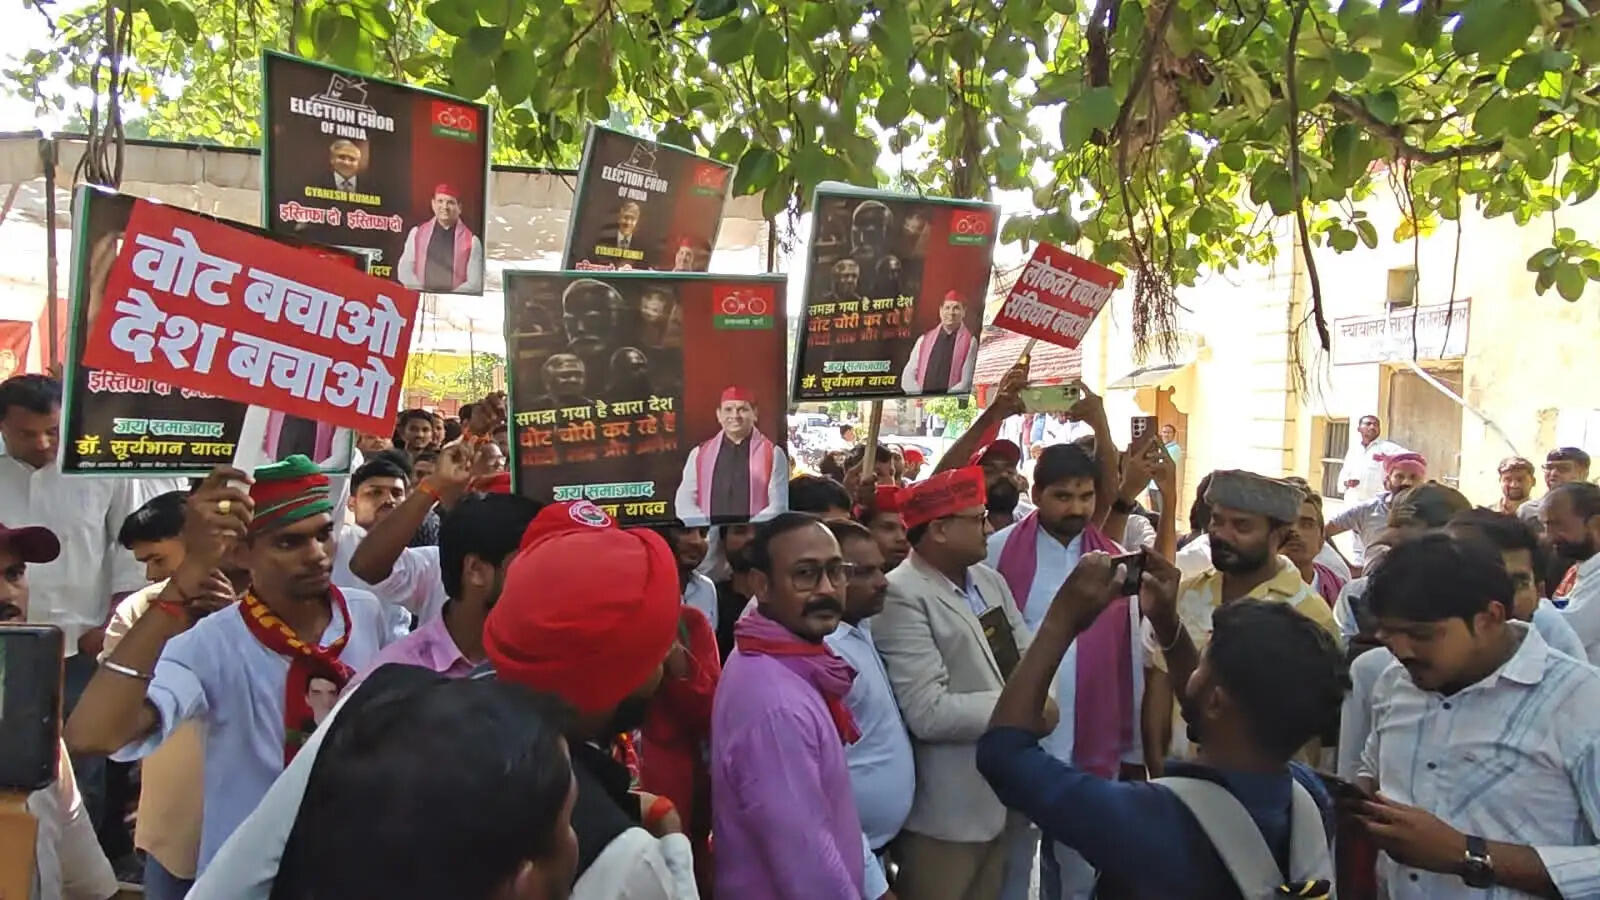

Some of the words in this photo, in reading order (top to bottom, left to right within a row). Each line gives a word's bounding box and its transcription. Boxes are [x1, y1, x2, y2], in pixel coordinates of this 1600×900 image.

[290, 97, 356, 125] ELECTION
[357, 111, 395, 132] CHOR
[321, 123, 335, 135] OF
[337, 125, 367, 141] INDIA
[602, 165, 642, 187] ELECTION
[644, 176, 669, 193] CHOR
[618, 186, 627, 197] OF
[627, 189, 648, 202] INDIA
[327, 207, 341, 226] दो
[131, 227, 242, 305] वोट
[243, 266, 406, 358] बचाओ
[808, 303, 836, 316] समझ
[838, 301, 859, 312] गया
[862, 296, 870, 311] है
[872, 298, 894, 310] सारा
[897, 294, 914, 307] देश
[833, 312, 859, 328] चोरी
[228, 331, 395, 419] बचाओ
[802, 375, 817, 389] डॉ.
[821, 374, 866, 392] सूर्यभान
[869, 375, 896, 386] यादव
[515, 409, 557, 426] समझ
[560, 406, 591, 421] गया
[595, 400, 607, 418] है
[611, 401, 643, 415] सारा
[648, 395, 674, 411] देश
[113, 418, 149, 435] जय
[149, 419, 224, 437] समाजवाद
[520, 427, 552, 447] वोट
[558, 421, 596, 442] चोरी
[602, 422, 631, 437] कर
[635, 414, 657, 434] रहे
[75, 435, 101, 454] डॉ.
[110, 435, 186, 460] सूर्यभान
[190, 441, 235, 456] यादव
[553, 484, 583, 500] जय
[585, 480, 655, 498] समाजवाद
[623, 501, 667, 517] यादव
